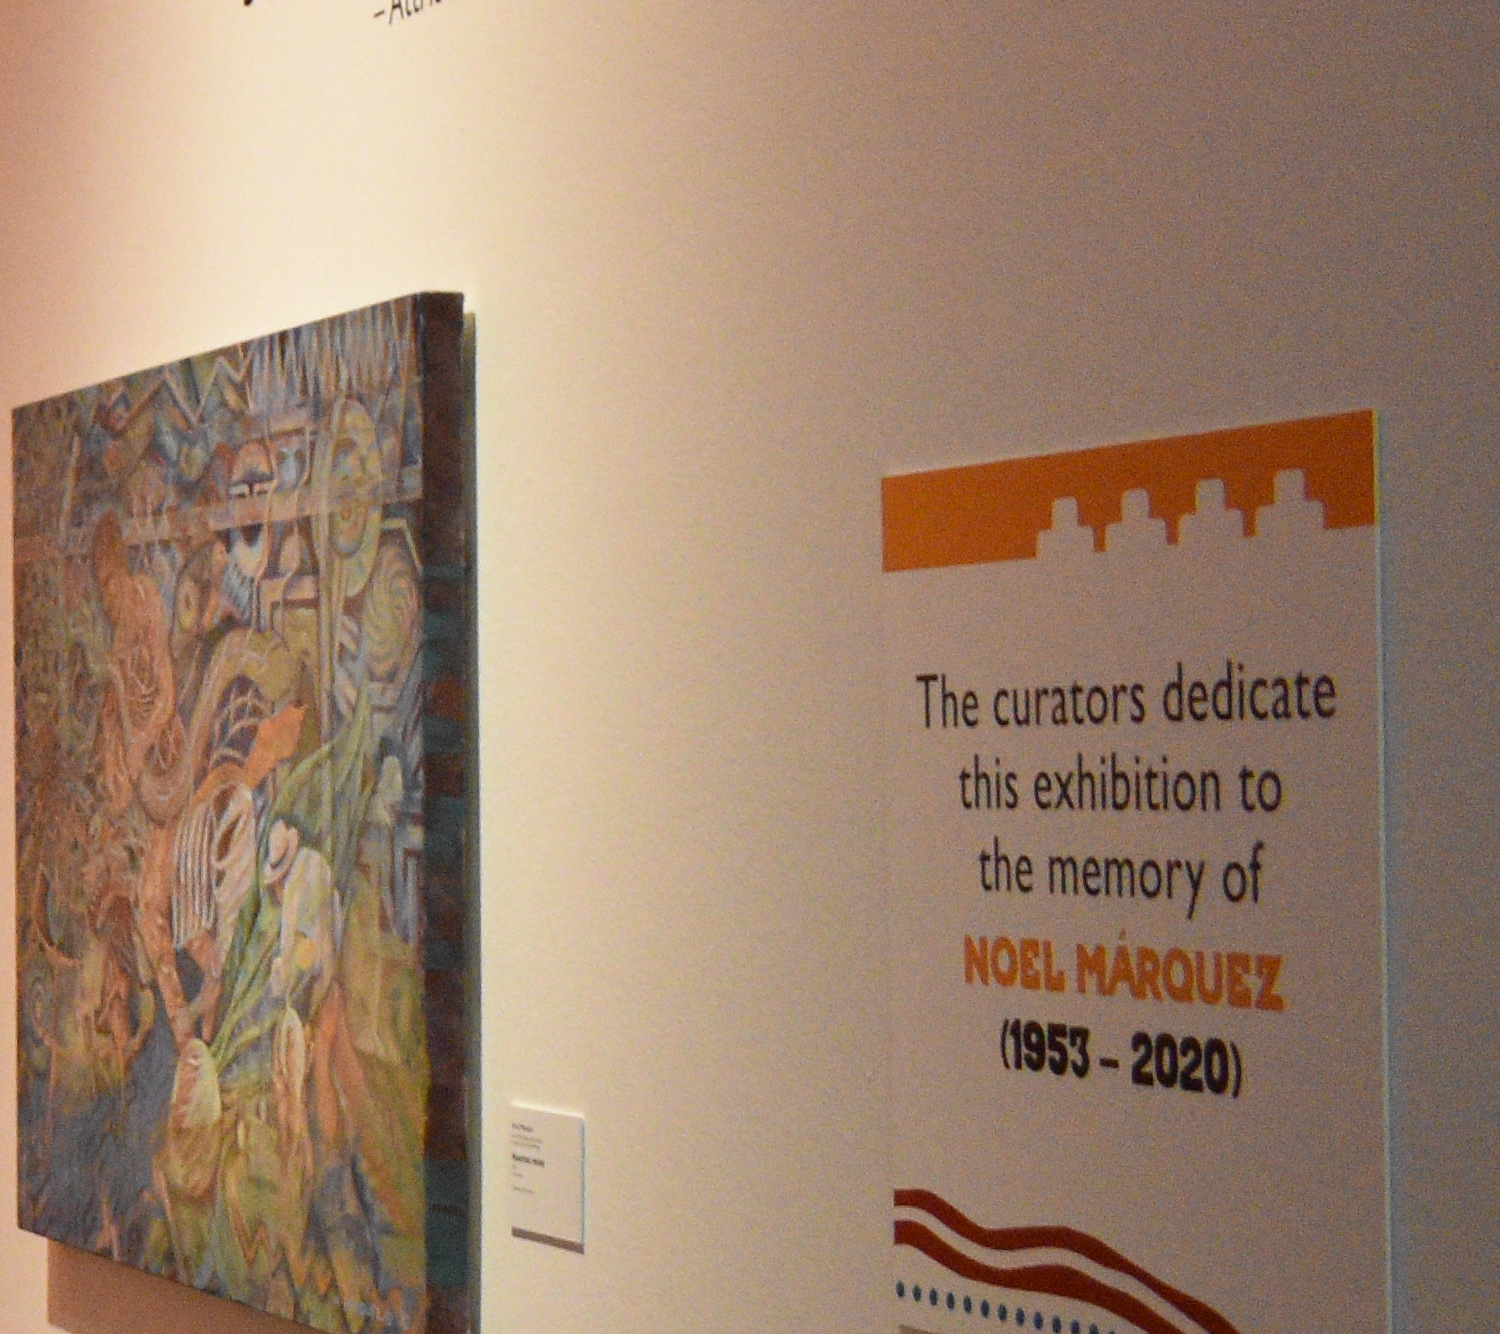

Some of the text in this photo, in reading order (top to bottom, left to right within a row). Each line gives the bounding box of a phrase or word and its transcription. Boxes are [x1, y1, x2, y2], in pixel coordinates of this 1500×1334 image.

[916, 660, 1338, 729] The curators dedicate
[959, 751, 1283, 813] this exhibition to
[979, 836, 1265, 920] the memory of
[963, 928, 1287, 1011] NOEL MÁRQUEZ
[1001, 1018, 1091, 1079] (1953
[1131, 1031, 1243, 1099] 2020)
